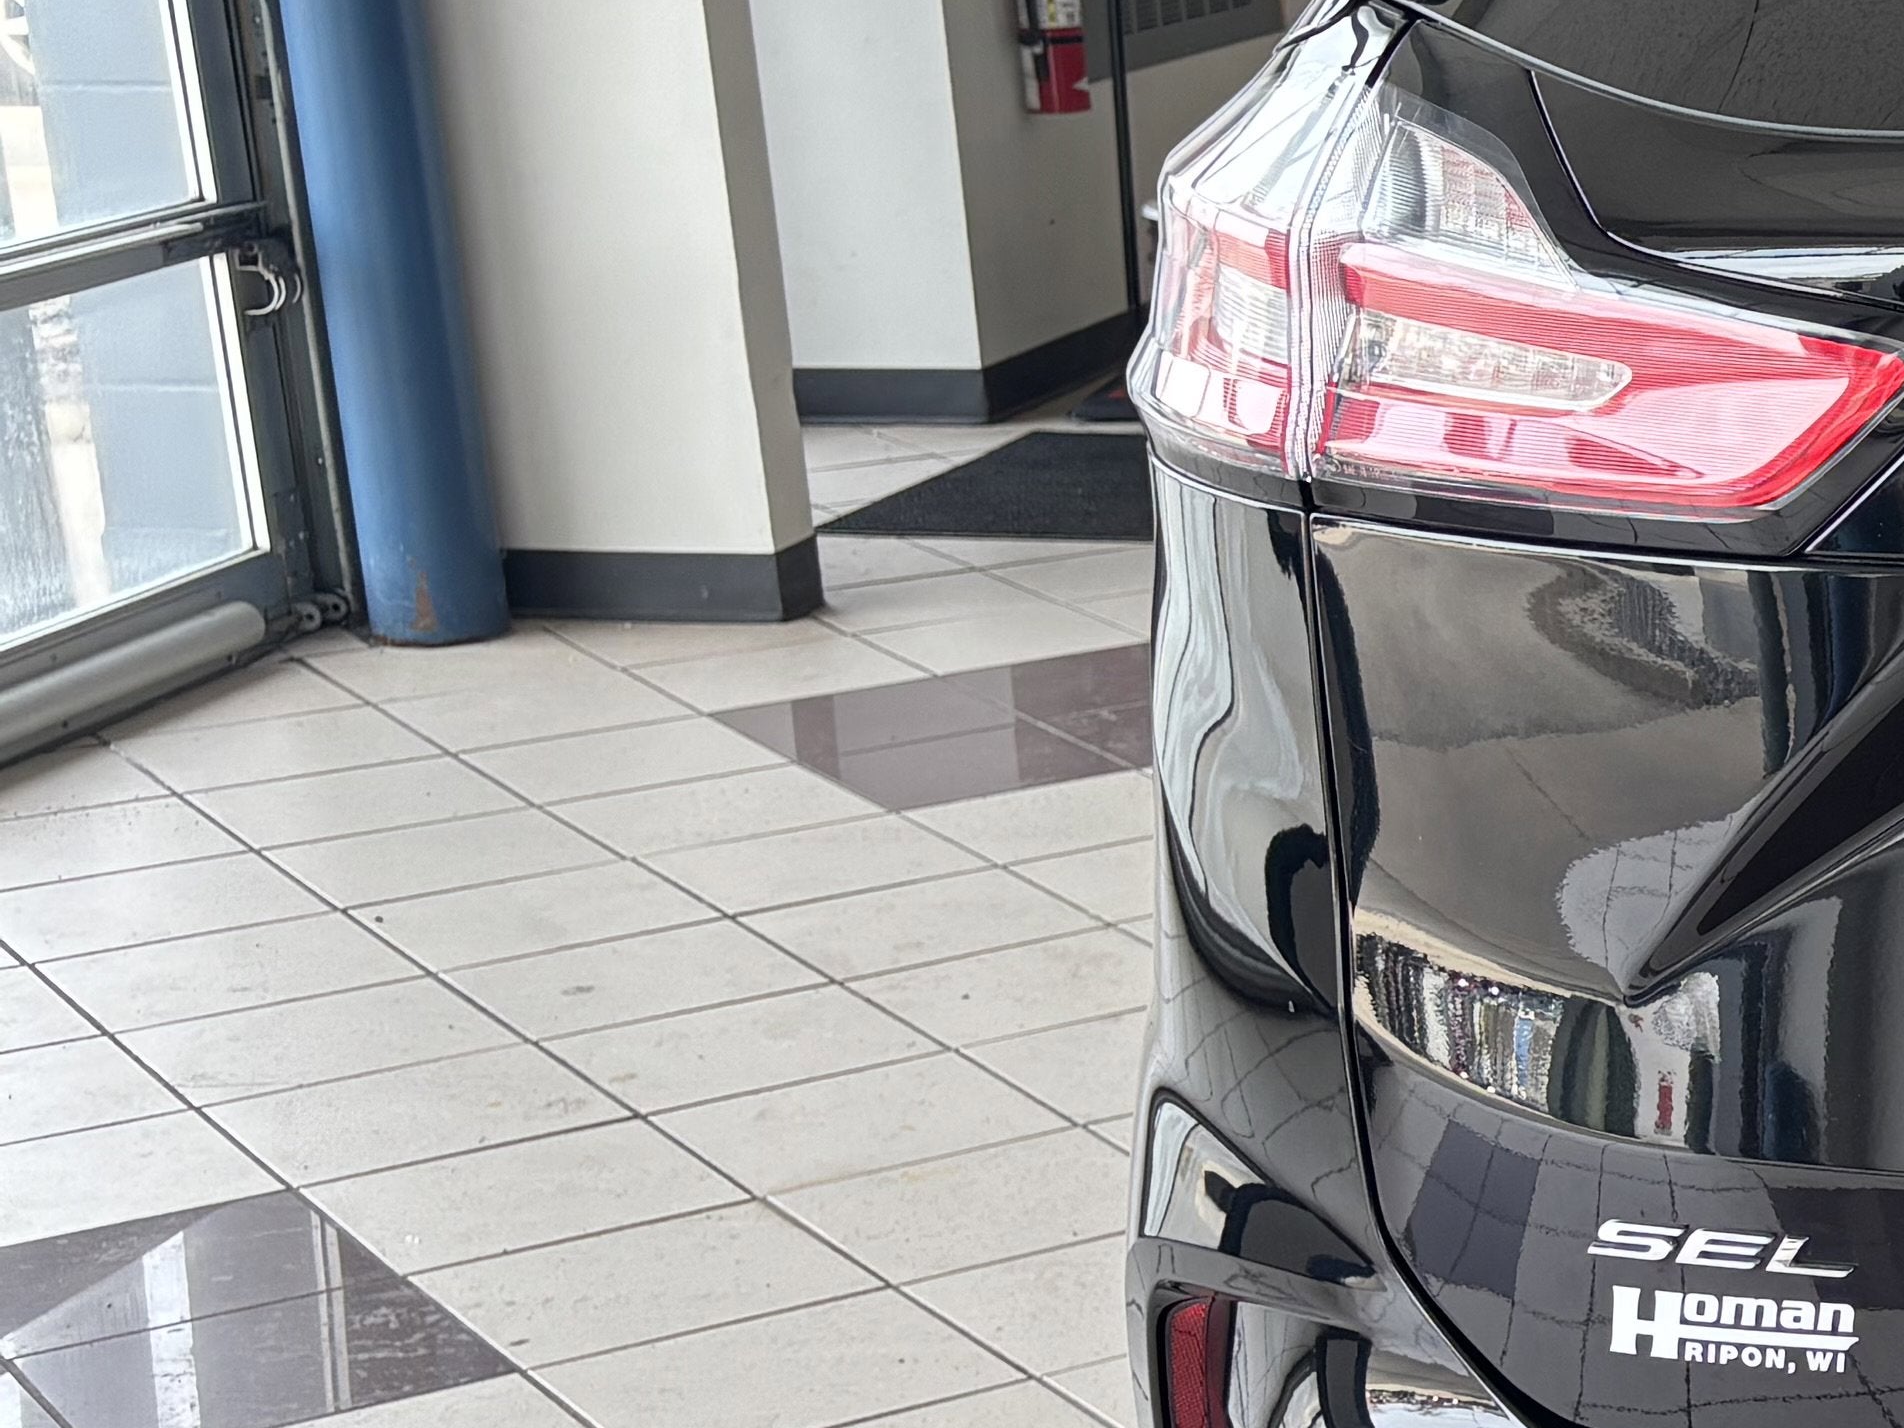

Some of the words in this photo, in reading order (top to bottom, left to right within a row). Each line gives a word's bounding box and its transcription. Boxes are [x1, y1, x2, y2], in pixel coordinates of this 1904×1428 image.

[1587, 1218, 1857, 1278] SEL
[1609, 1284, 1856, 1360] Homan
[1684, 1341, 1796, 1374] RIPON,
[1806, 1350, 1846, 1373] WI
